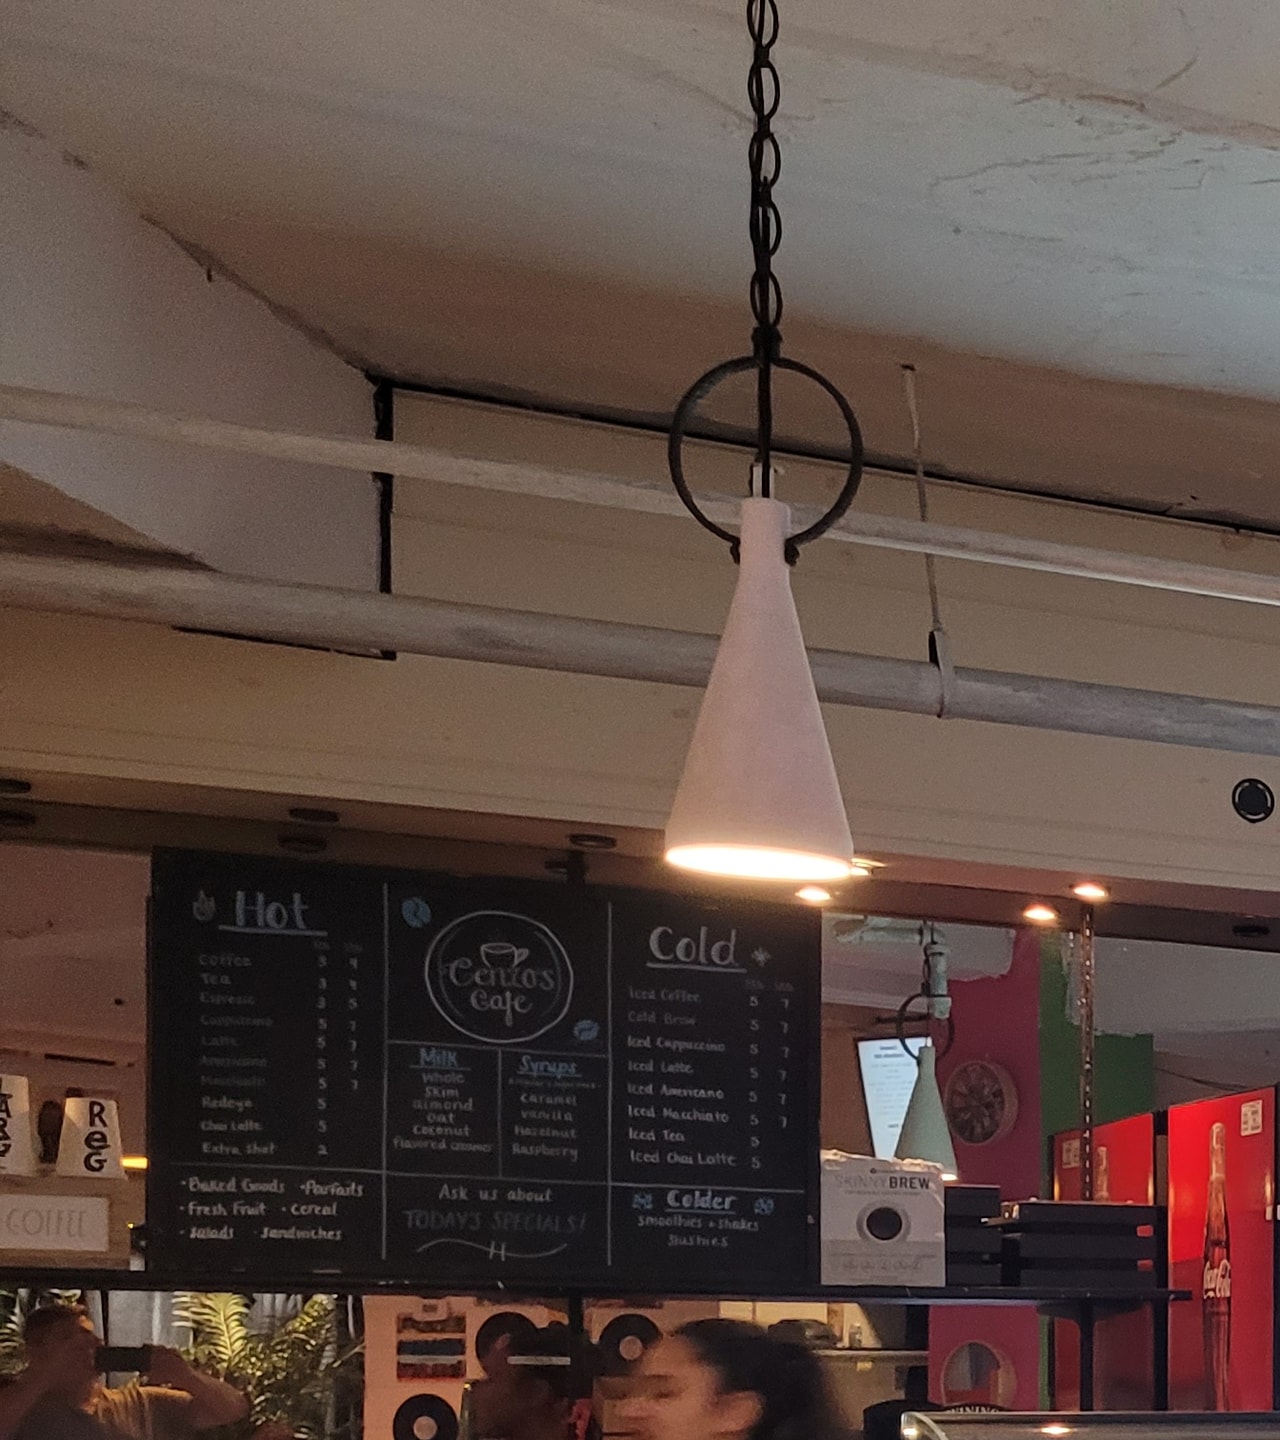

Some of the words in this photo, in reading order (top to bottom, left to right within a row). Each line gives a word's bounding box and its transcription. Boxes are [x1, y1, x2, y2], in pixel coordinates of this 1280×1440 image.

[235, 890, 309, 929] Hot
[648, 926, 737, 966] Cold
[470, 988, 533, 1027] Cafe
[629, 985, 656, 1000] Iced
[660, 988, 700, 1004] Coffee
[749, 996, 759, 1008] 5
[781, 998, 790, 1010] 7
[317, 1018, 327, 1031] 5
[628, 1009, 656, 1024] Cold
[664, 1011, 696, 1026] Brew
[750, 1018, 759, 1031] 5
[780, 1021, 789, 1034] 7
[317, 1036, 326, 1050] 5
[348, 1039, 357, 1053] 7
[626, 1034, 652, 1049] Iced
[749, 1043, 759, 1055] 5
[781, 1045, 790, 1059] 7
[317, 1058, 326, 1071] 5
[349, 1059, 358, 1073] 7
[419, 1047, 459, 1068] Milk
[518, 1054, 579, 1080] Syrups
[628, 1058, 654, 1073] Iced
[660, 1059, 694, 1075] Latte
[750, 1066, 759, 1079] 5
[779, 1069, 788, 1082] 7
[318, 1078, 327, 1091] 5
[350, 1078, 359, 1092] 7
[627, 1082, 654, 1096] Iced
[660, 1084, 725, 1100] Americano
[748, 1090, 758, 1103] 5
[778, 1092, 787, 1105] 7
[317, 1098, 327, 1111] 5
[318, 1120, 327, 1133] 5
[628, 1104, 655, 1119] Iced
[750, 1113, 759, 1126] 5
[779, 1115, 788, 1129] 7
[629, 1126, 656, 1141] Iced
[662, 1128, 685, 1142] Tea
[751, 1136, 760, 1148] 5
[202, 1141, 242, 1155] Extra
[318, 1144, 328, 1156] 2
[512, 1142, 579, 1161] Raspberry
[630, 1148, 660, 1164] Iced
[697, 1152, 737, 1168] Latte
[751, 1156, 761, 1169] 5
[188, 1178, 237, 1194] Baked
[242, 1179, 286, 1195] Goods
[438, 1183, 469, 1201] Ask
[479, 1187, 497, 1201] us
[506, 1185, 554, 1202] about
[889, 1176, 930, 1190] BREW
[188, 1202, 228, 1217] Fresh
[232, 1201, 266, 1217] Fruit
[667, 1189, 737, 1211] Colder
